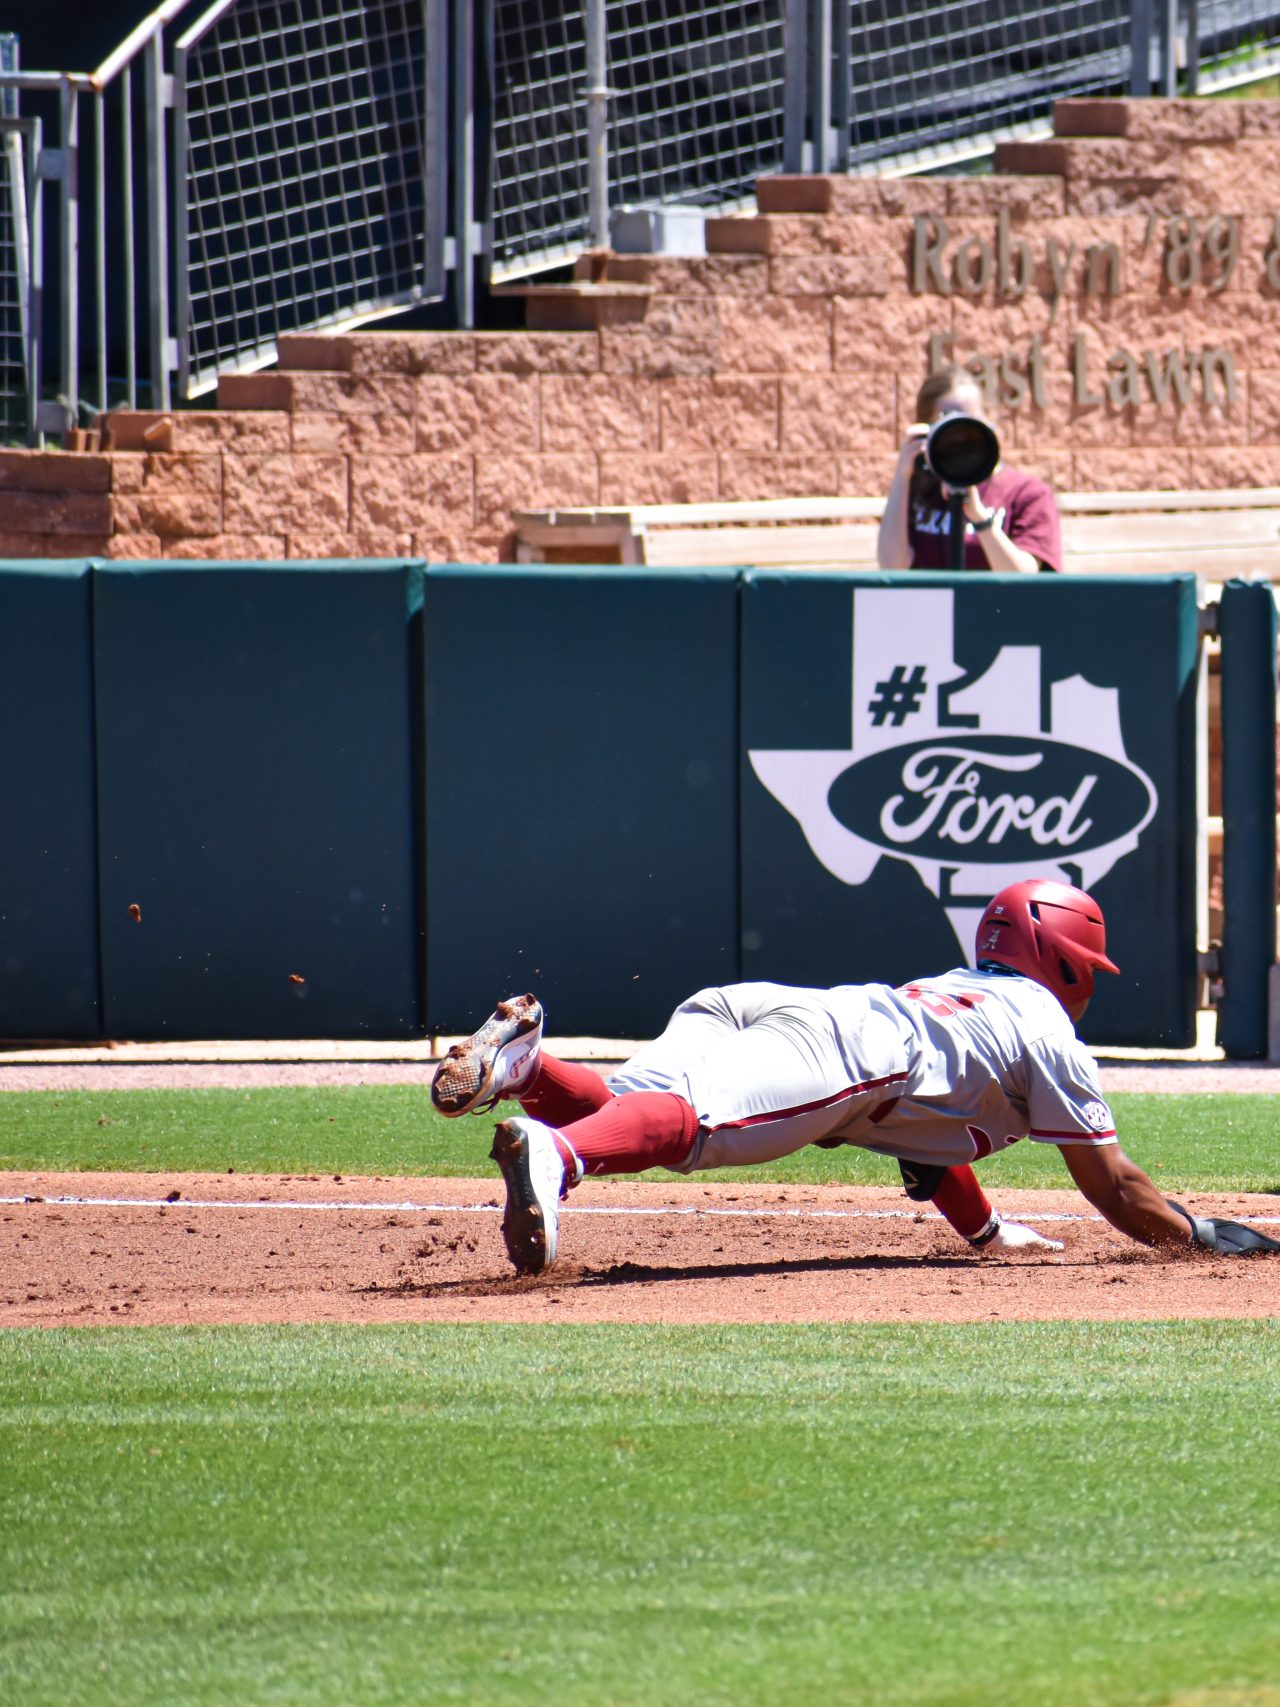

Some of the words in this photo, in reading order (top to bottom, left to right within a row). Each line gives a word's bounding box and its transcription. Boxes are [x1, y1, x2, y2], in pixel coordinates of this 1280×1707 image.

[912, 206, 1121, 322] Robyn
[1143, 211, 1240, 290] '89
[1073, 331, 1240, 406] Lawn
[880, 746, 1098, 846] Ford
